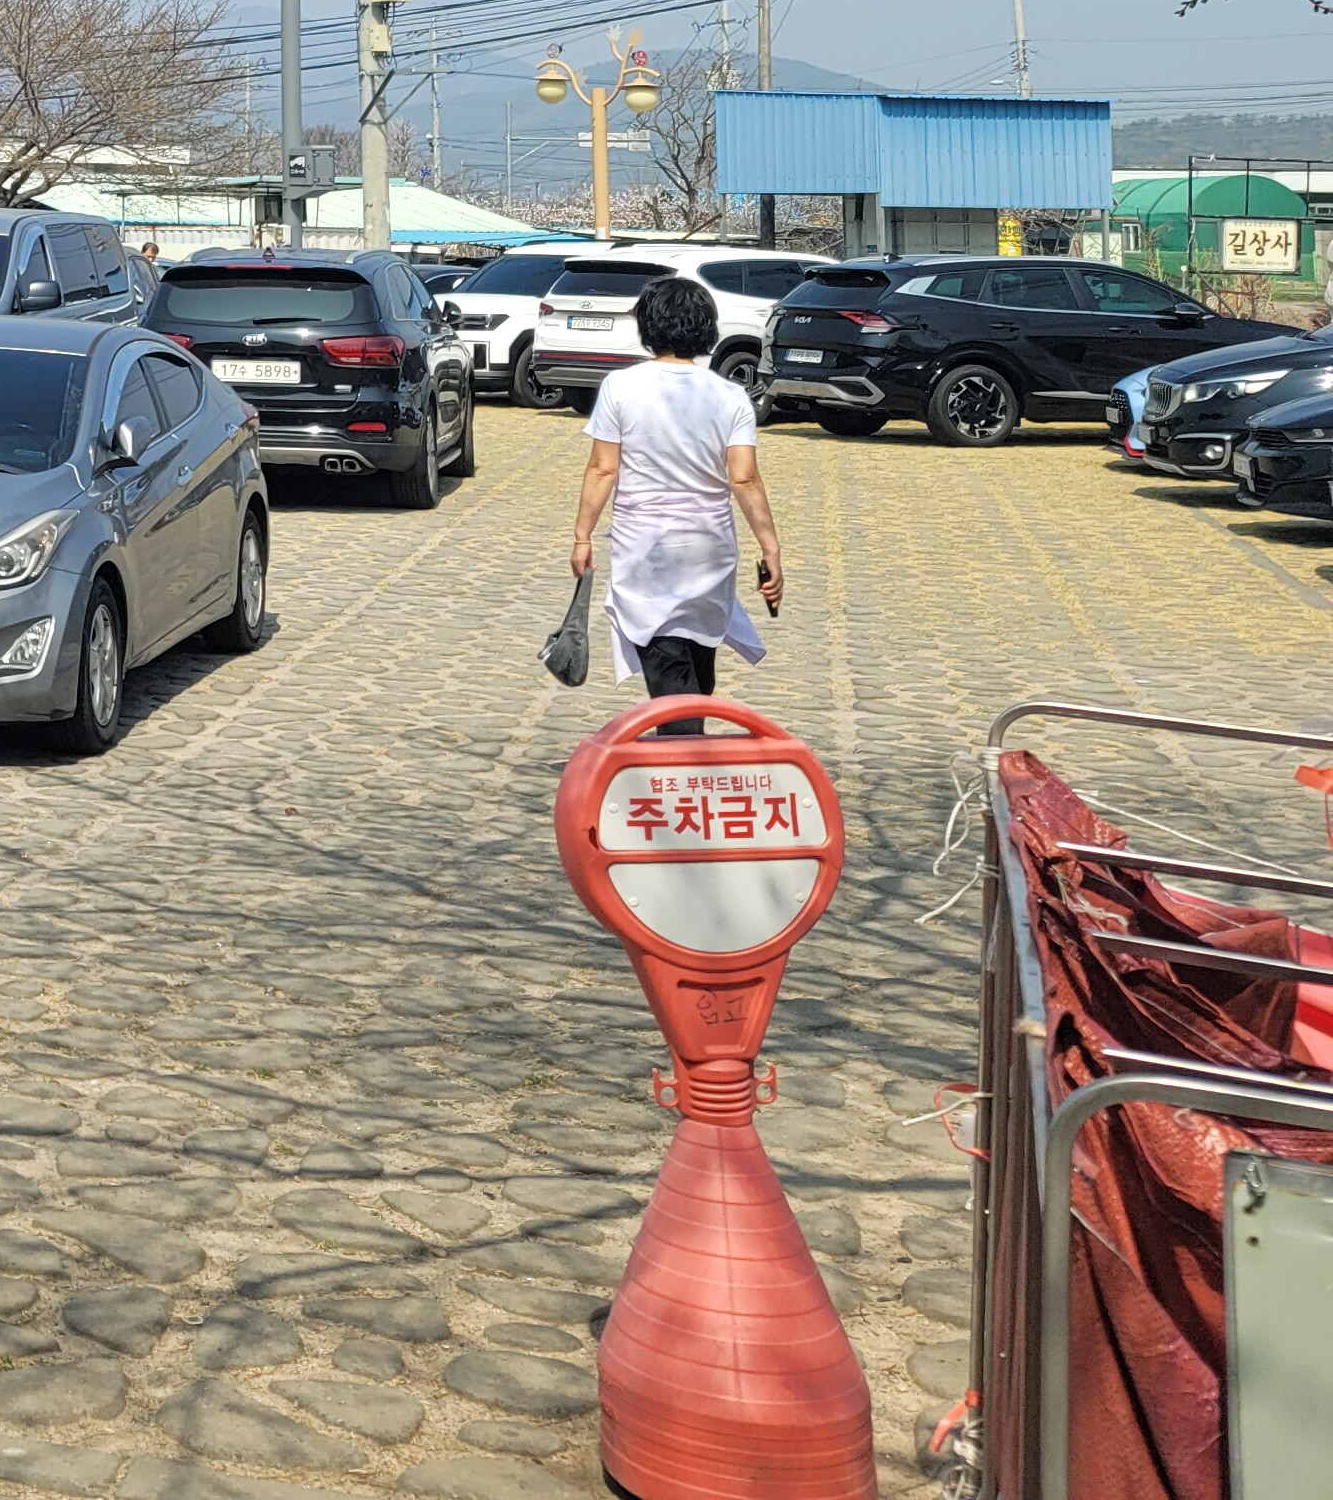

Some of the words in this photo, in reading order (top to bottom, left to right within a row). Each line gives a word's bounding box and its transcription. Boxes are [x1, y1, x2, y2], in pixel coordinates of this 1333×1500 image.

[1227, 230, 1293, 257] 길상사
[221, 363, 247, 377] 17수
[254, 364, 291, 378] 5898
[650, 776, 680, 793] 협조
[686, 774, 773, 792] 부탁드립니다
[626, 792, 800, 841] 주차금지
